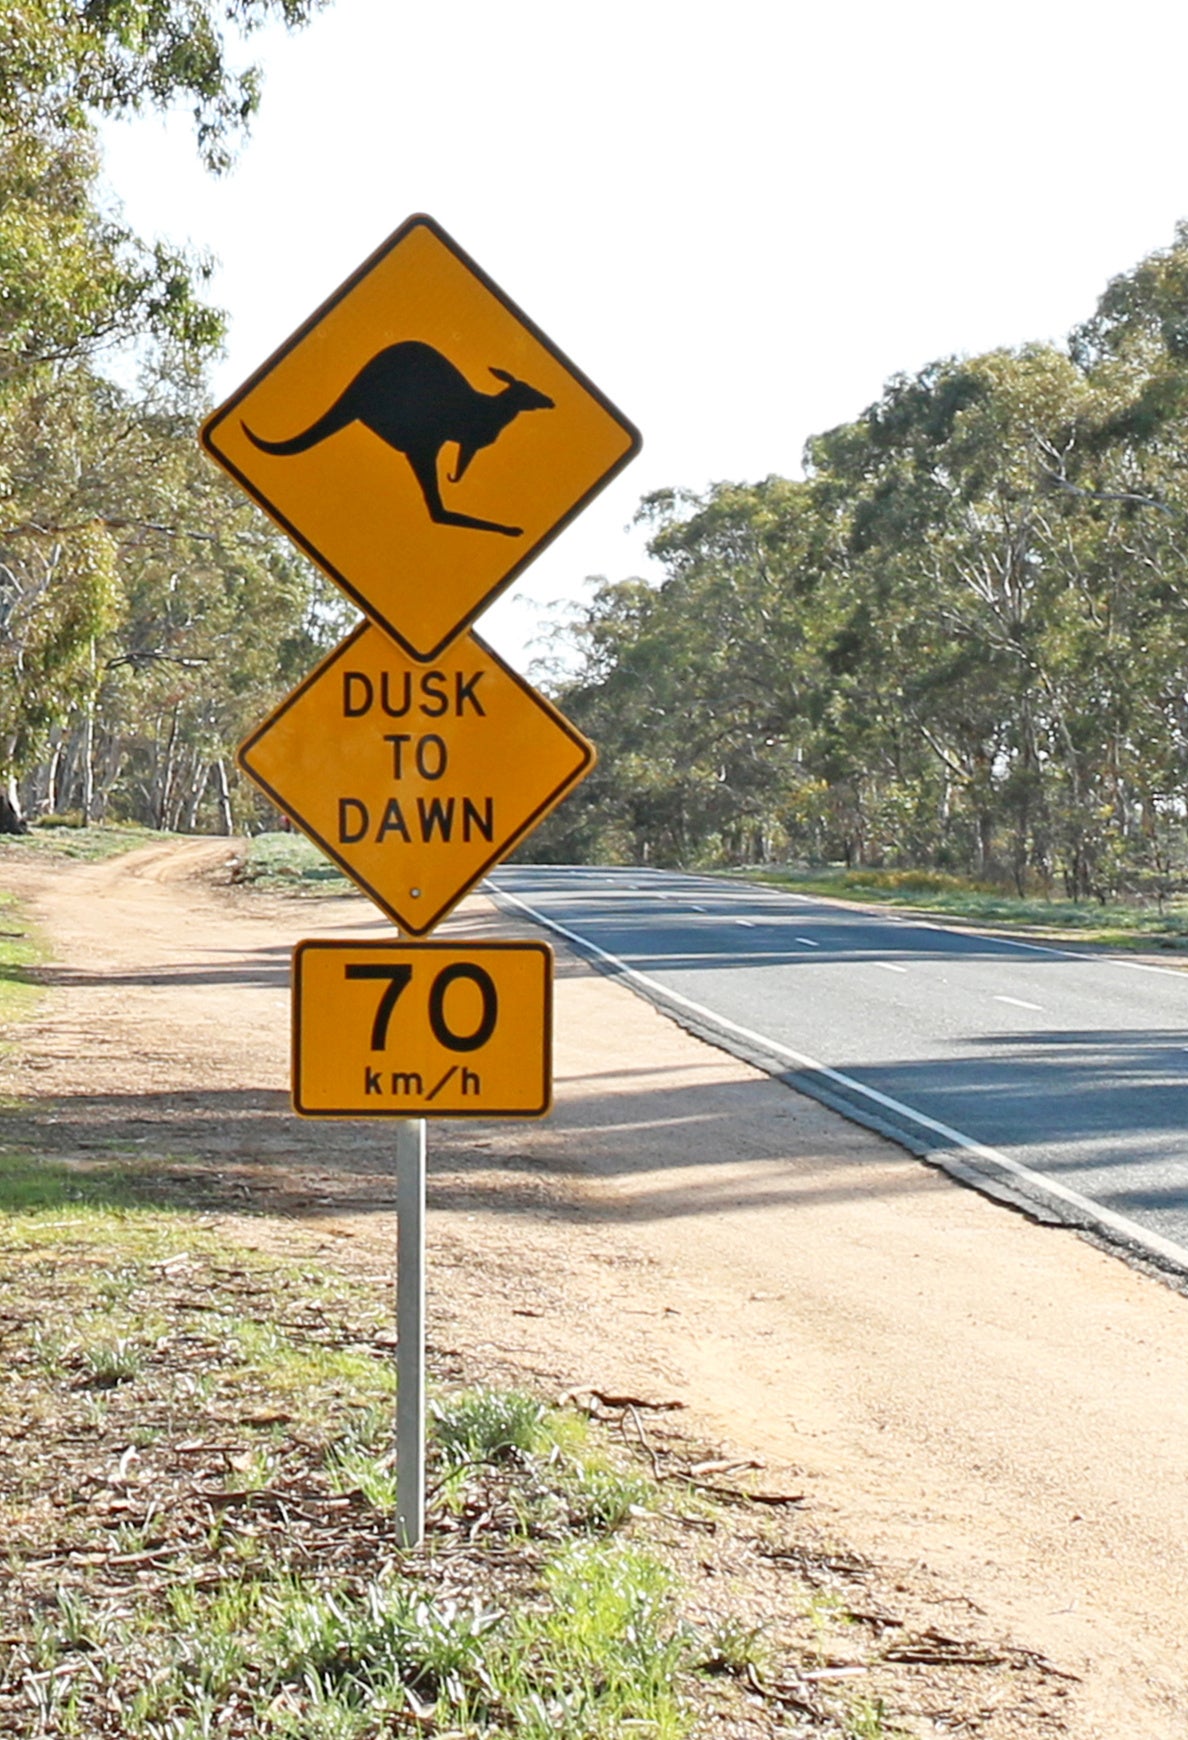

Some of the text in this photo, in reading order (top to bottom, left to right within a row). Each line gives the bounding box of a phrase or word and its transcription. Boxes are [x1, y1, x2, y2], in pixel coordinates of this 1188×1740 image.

[344, 671, 486, 718] DUSK
[384, 734, 448, 781] TO
[339, 797, 494, 844] DAWN
[344, 962, 498, 1053] 70
[365, 1066, 481, 1101] km/h
